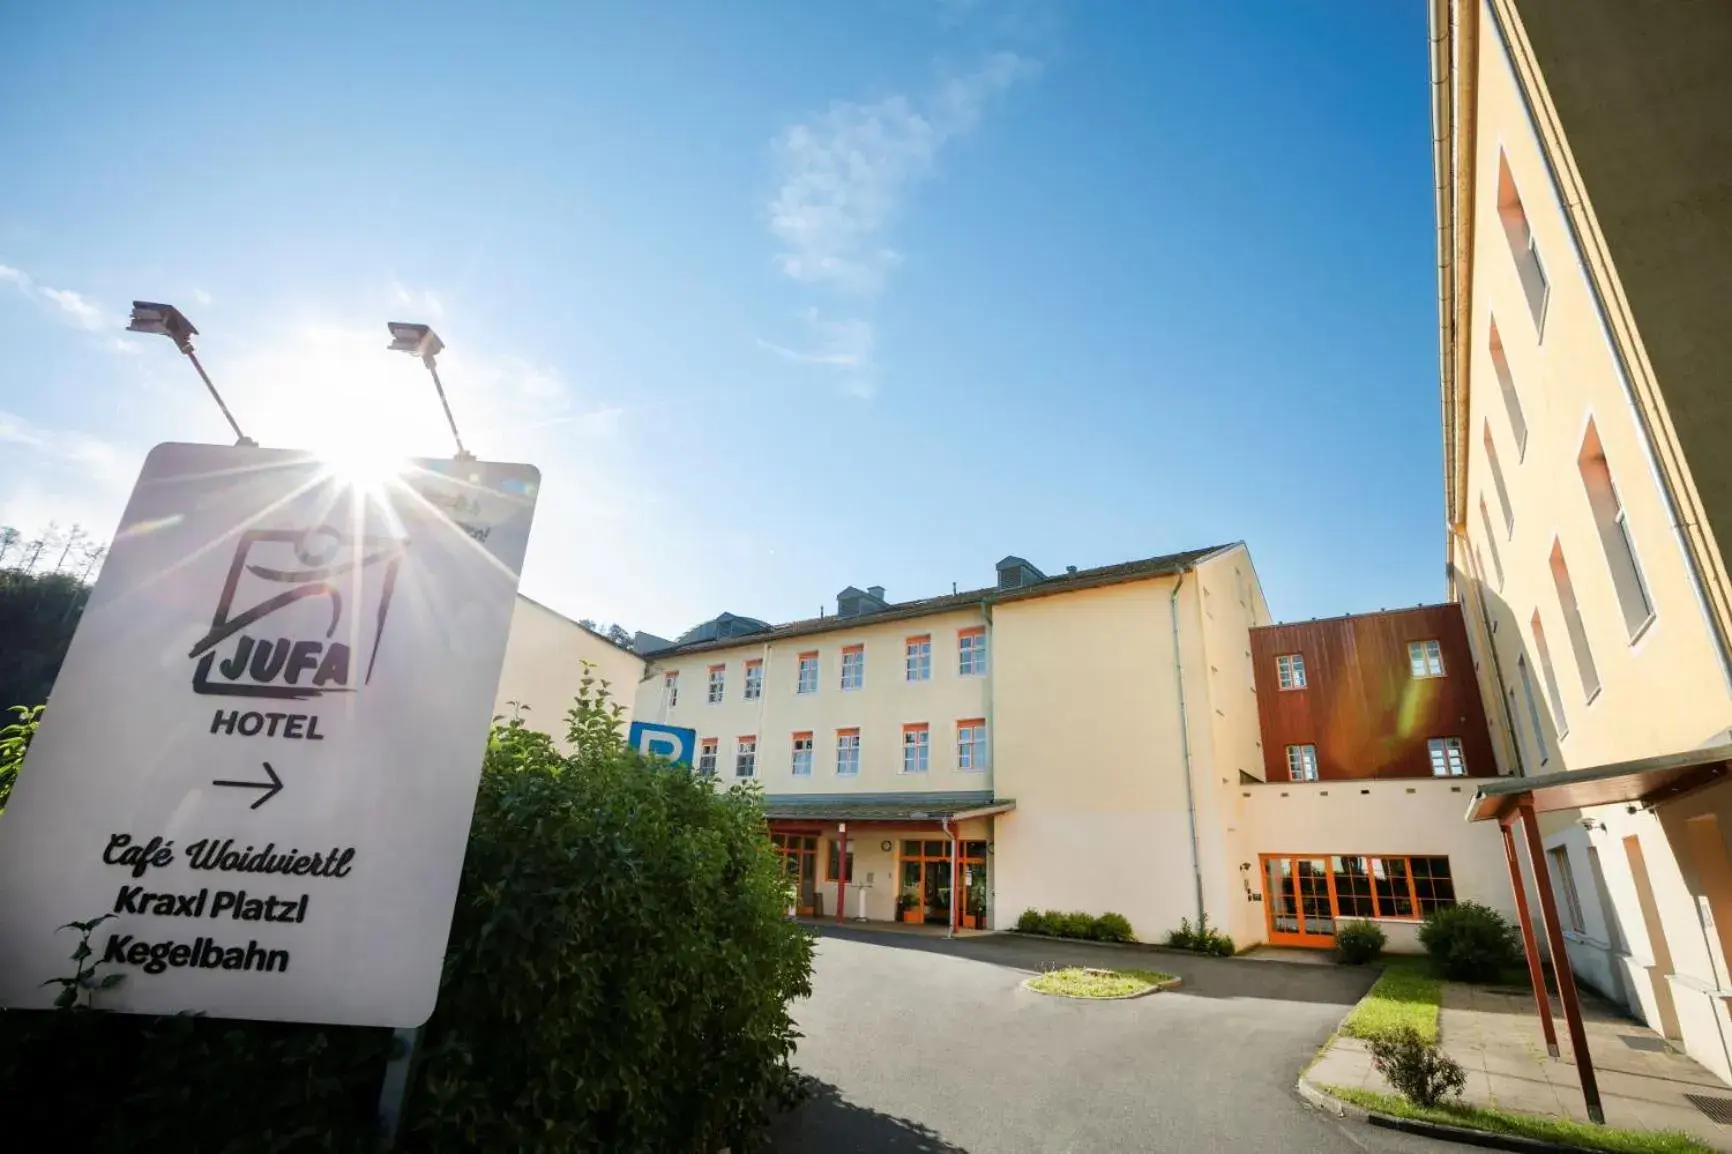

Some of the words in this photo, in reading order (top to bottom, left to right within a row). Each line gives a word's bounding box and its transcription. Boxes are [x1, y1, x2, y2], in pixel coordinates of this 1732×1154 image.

[219, 635, 351, 686] JUFA
[210, 709, 324, 740] HOTEL
[103, 833, 174, 877] Café
[113, 886, 208, 917] Kraxl
[209, 890, 309, 923] Platzl
[103, 934, 290, 974] Kegelbahn
